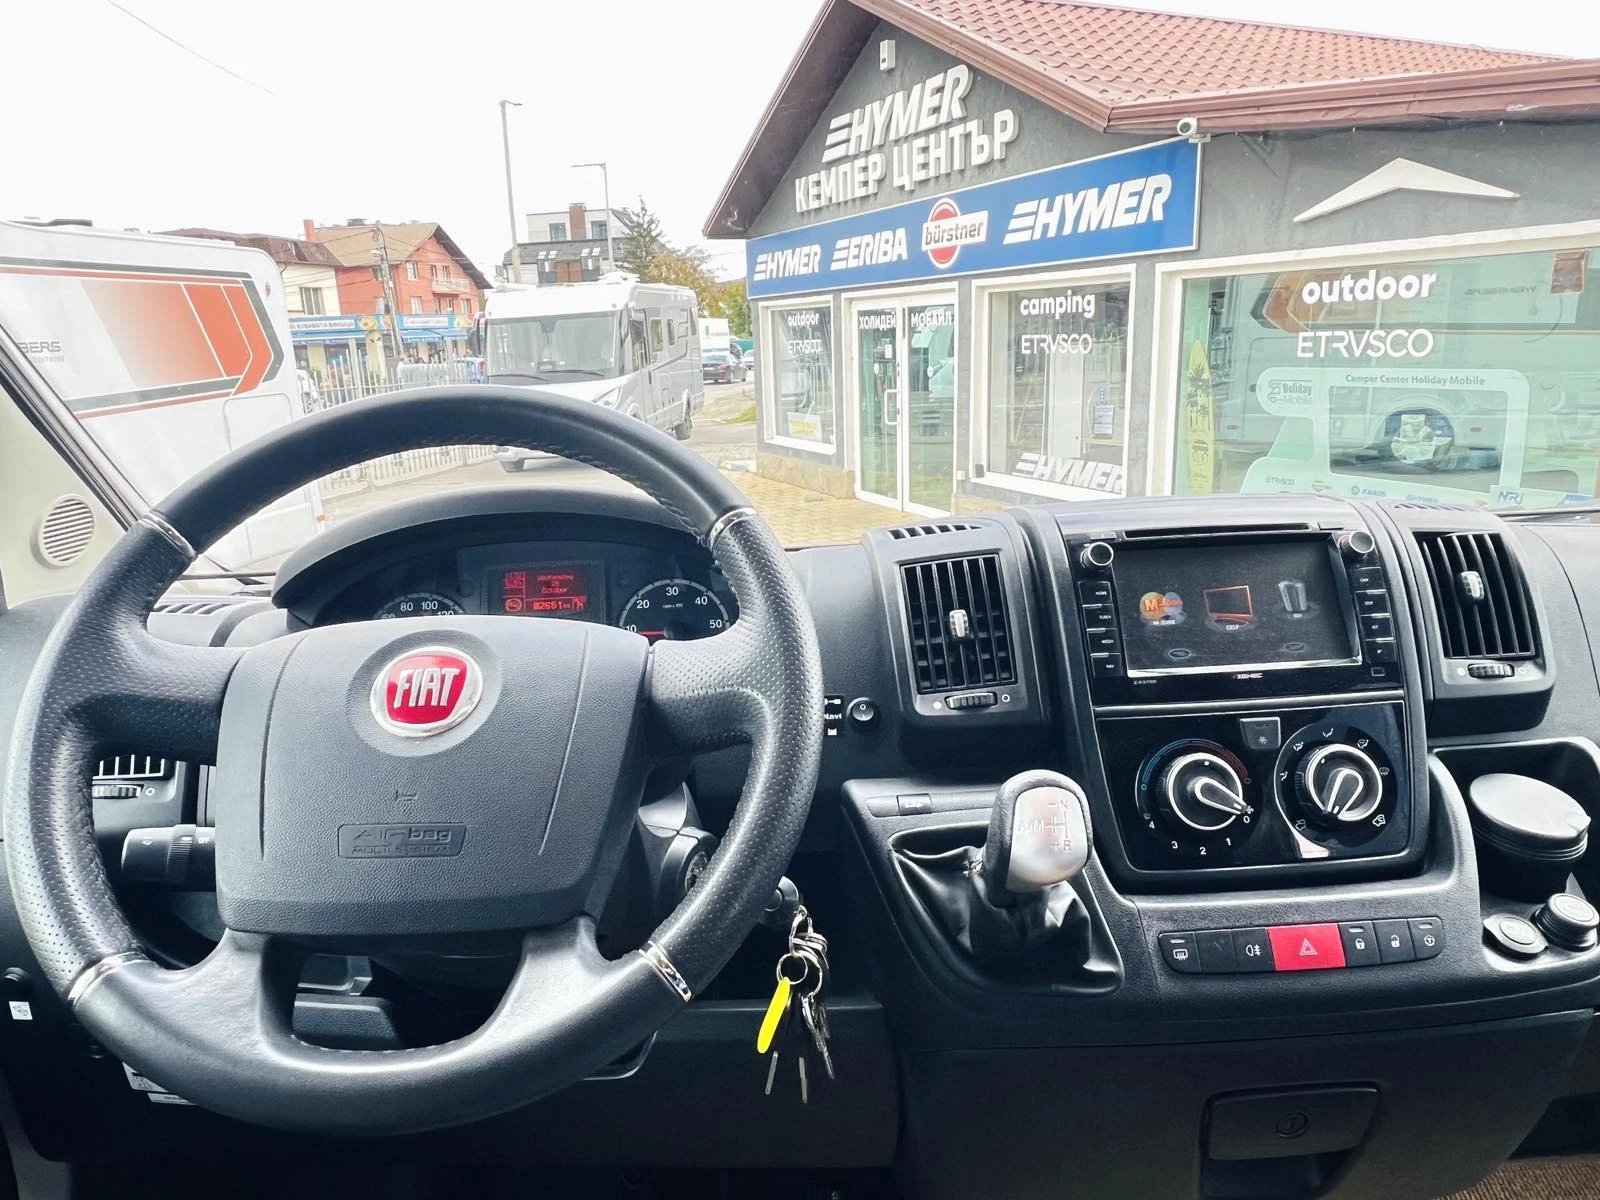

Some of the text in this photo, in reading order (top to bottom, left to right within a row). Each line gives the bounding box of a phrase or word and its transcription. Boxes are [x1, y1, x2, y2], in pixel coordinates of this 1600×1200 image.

[846, 64, 973, 156] HYMER
[795, 108, 1020, 213] КЕМПЕР ЦЕНТЪР
[1031, 173, 1172, 241] HYMER
[924, 219, 985, 247] bürstner
[845, 227, 909, 268] ERIBA
[765, 243, 822, 280] HYMER
[1301, 269, 1438, 305] outdoor
[1020, 289, 1096, 320] camping
[787, 311, 819, 327] outdoor
[1345, 373, 1486, 387] Camper Center Holiday Mobile
[1282, 382, 1313, 396] Holiday
[665, 586, 679, 596] 30
[400, 600, 438, 611] 80 100
[636, 599, 650, 609] 20
[694, 596, 708, 605] 40
[709, 619, 723, 629] 50
[393, 667, 461, 709] FIAT
[1148, 820, 1155, 829] 4
[1243, 815, 1251, 824] 0
[1063, 839, 1072, 851] R
[1171, 841, 1179, 849] 3
[1226, 837, 1232, 846] 1
[1200, 846, 1207, 855] 2
